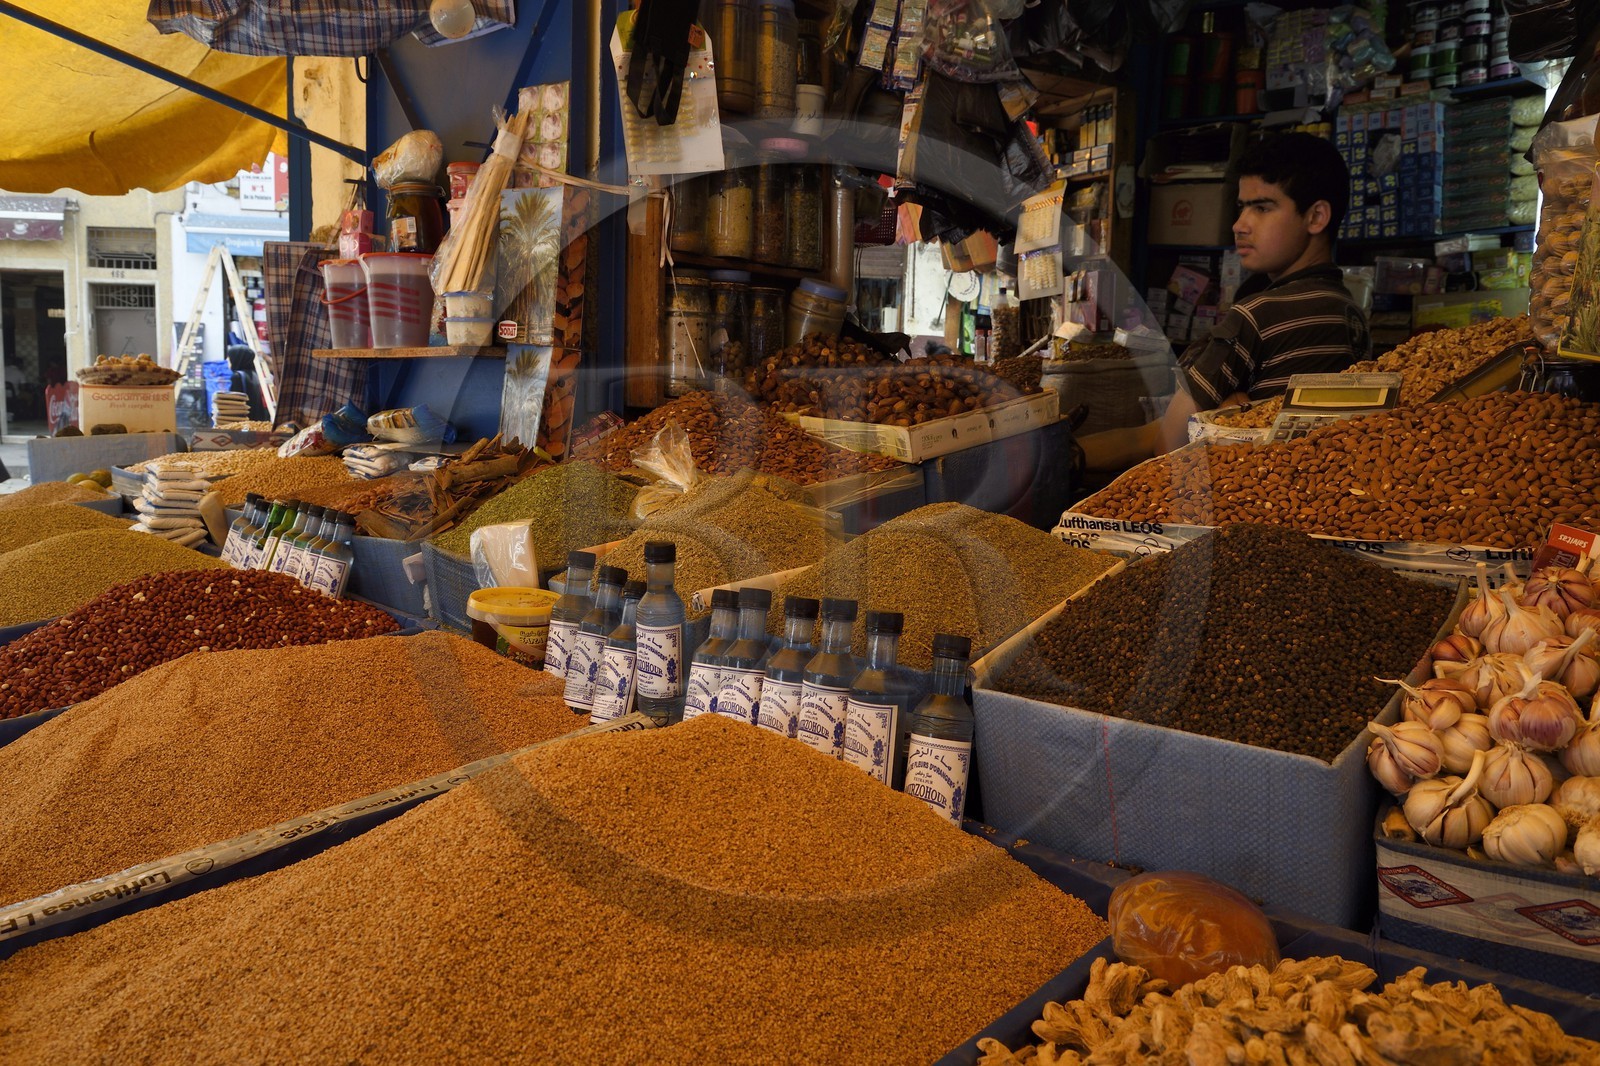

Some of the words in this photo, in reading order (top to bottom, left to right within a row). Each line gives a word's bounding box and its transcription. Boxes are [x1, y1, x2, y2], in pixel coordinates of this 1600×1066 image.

[1060, 517, 1120, 532] Lufthansa
[1122, 520, 1164, 534] LEOS
[1558, 534, 1588, 548] Salvitas
[42, 870, 172, 916] Lufthansa
